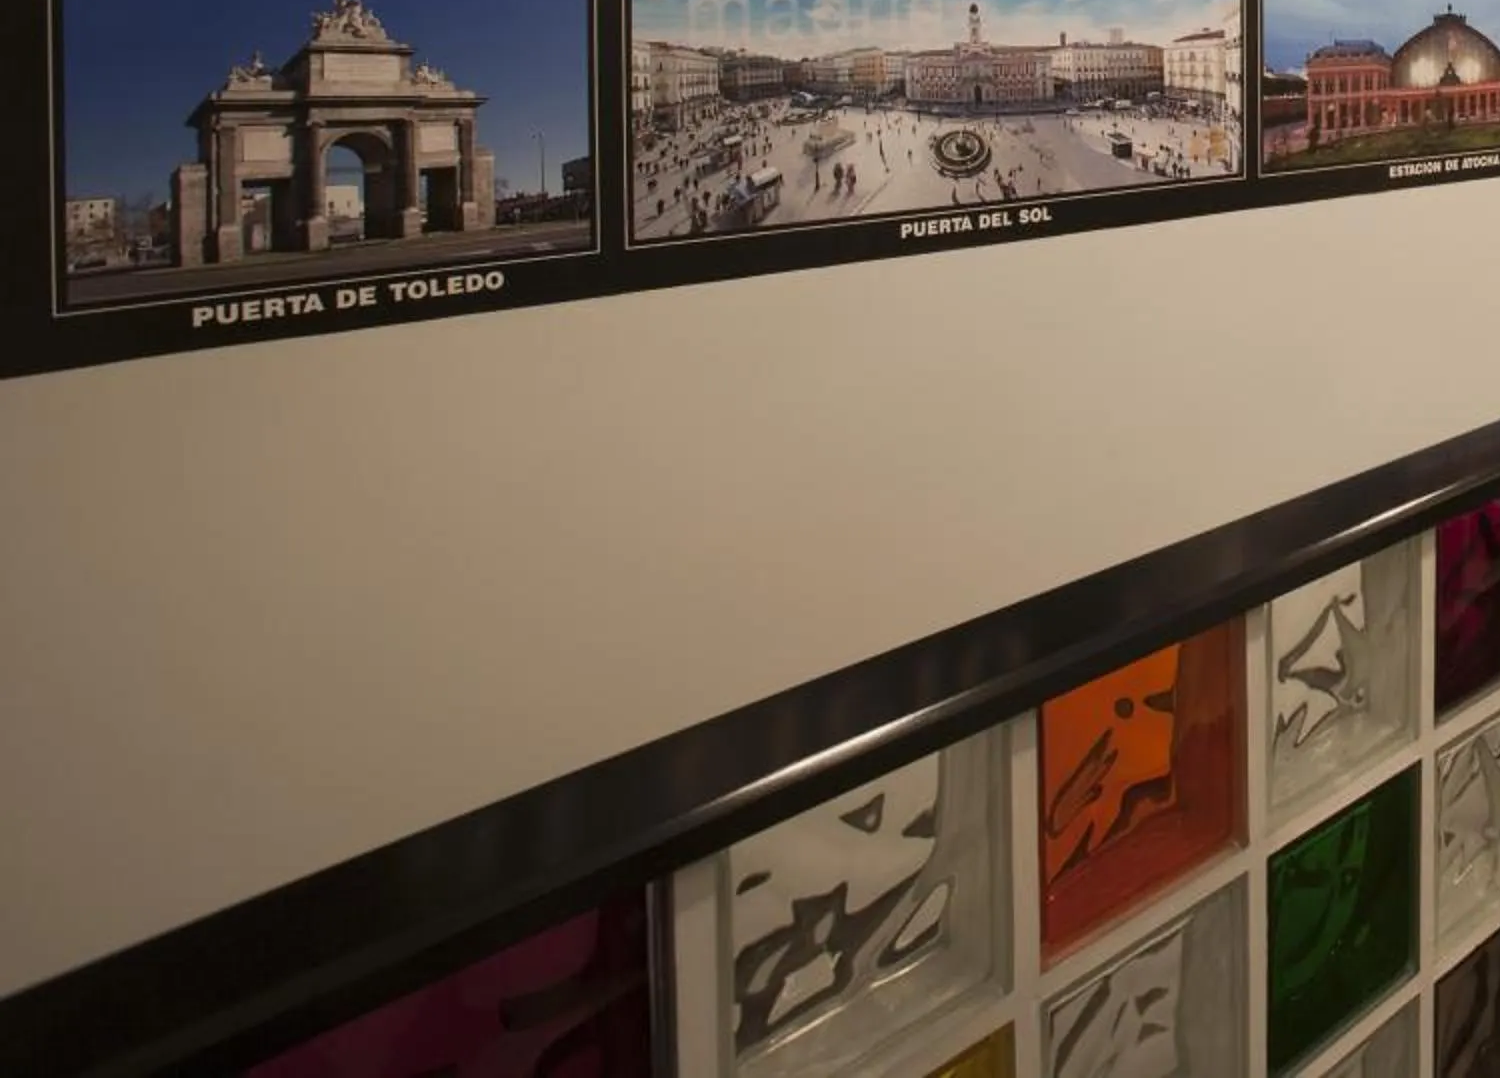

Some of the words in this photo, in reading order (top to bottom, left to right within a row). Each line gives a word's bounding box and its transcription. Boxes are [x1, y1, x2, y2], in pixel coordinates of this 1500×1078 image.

[1445, 158, 1459, 171] DE
[1461, 154, 1500, 170] ATOCHA
[900, 215, 973, 239] PUERTA
[979, 211, 1012, 229] DEL
[1019, 206, 1052, 223] SOL
[192, 293, 325, 327] PUERTA
[336, 286, 377, 310] DE
[388, 272, 505, 303] TOLEDO
